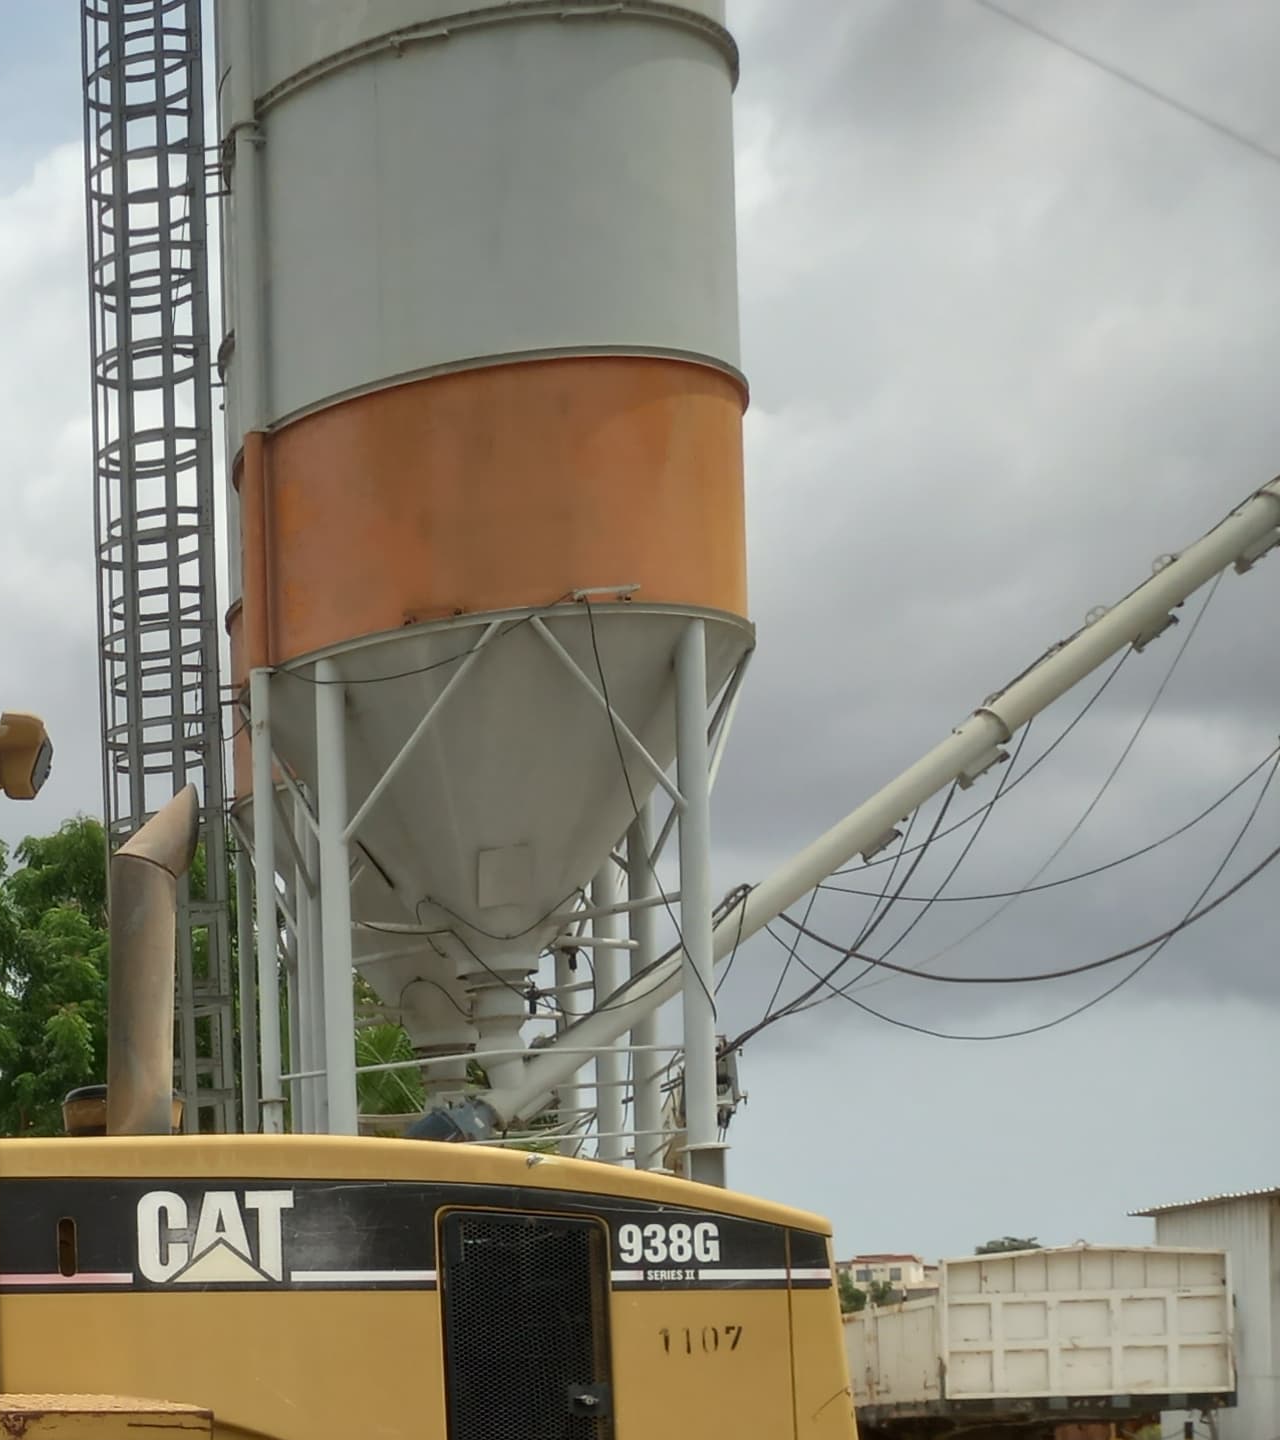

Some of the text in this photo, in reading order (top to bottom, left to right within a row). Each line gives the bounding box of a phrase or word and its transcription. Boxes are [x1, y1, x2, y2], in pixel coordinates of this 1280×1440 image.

[137, 1190, 294, 1283] CAT
[618, 1222, 720, 1263] 938G
[646, 1269, 684, 1281] SERIES
[659, 1326, 742, 1354] 1107
